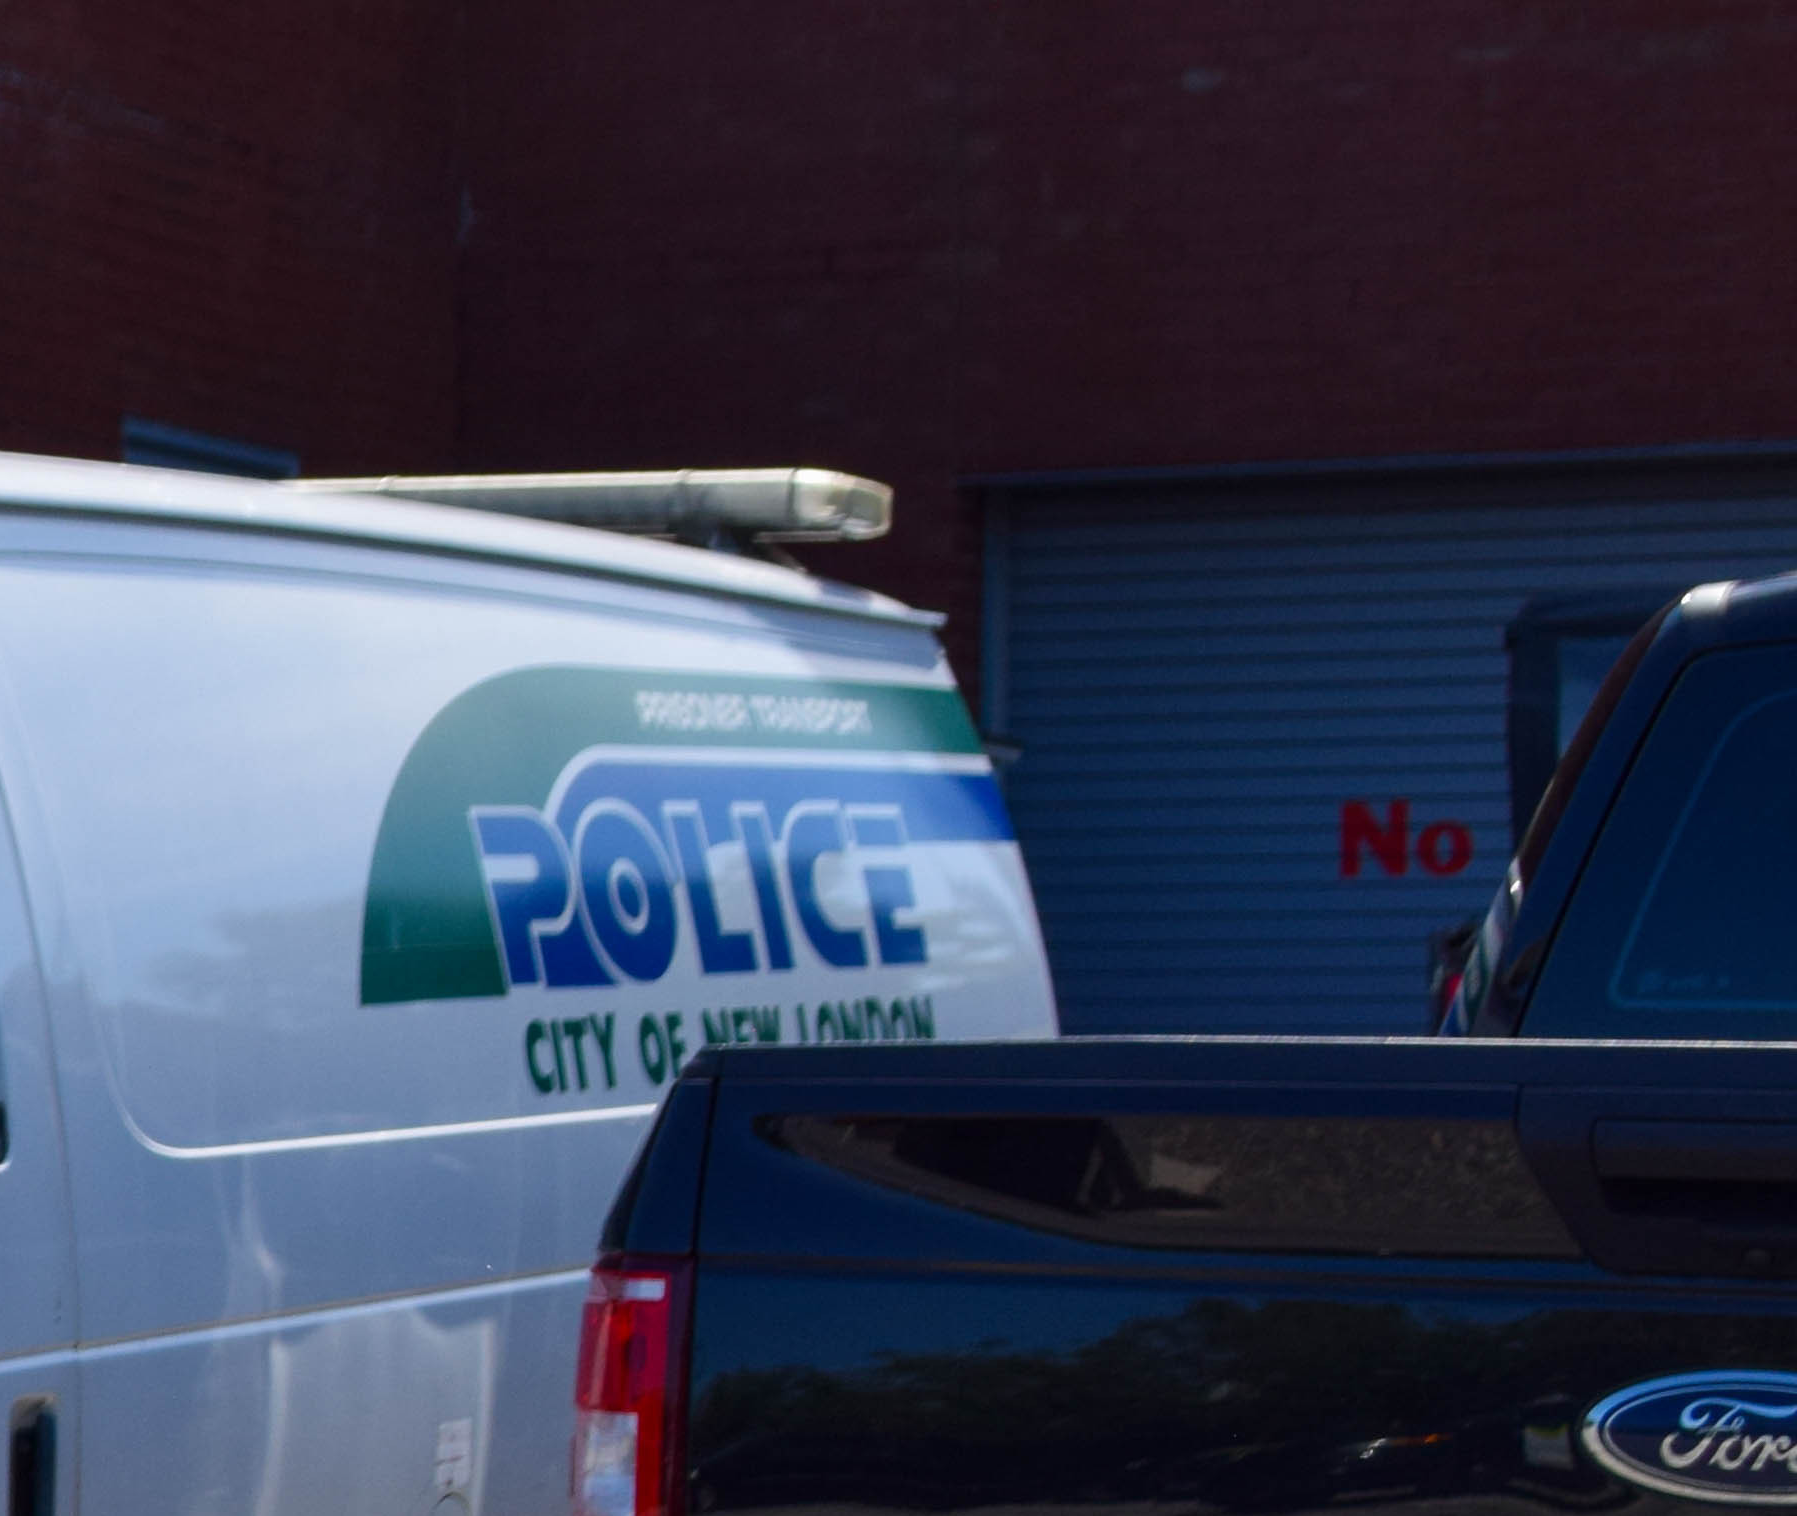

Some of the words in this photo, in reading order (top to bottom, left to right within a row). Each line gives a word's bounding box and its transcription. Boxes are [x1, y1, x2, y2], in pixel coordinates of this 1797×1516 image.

[1339, 798, 1474, 878] No
[469, 798, 930, 988] POLICE
[526, 1012, 617, 1094] CITY
[639, 1011, 686, 1086] OF
